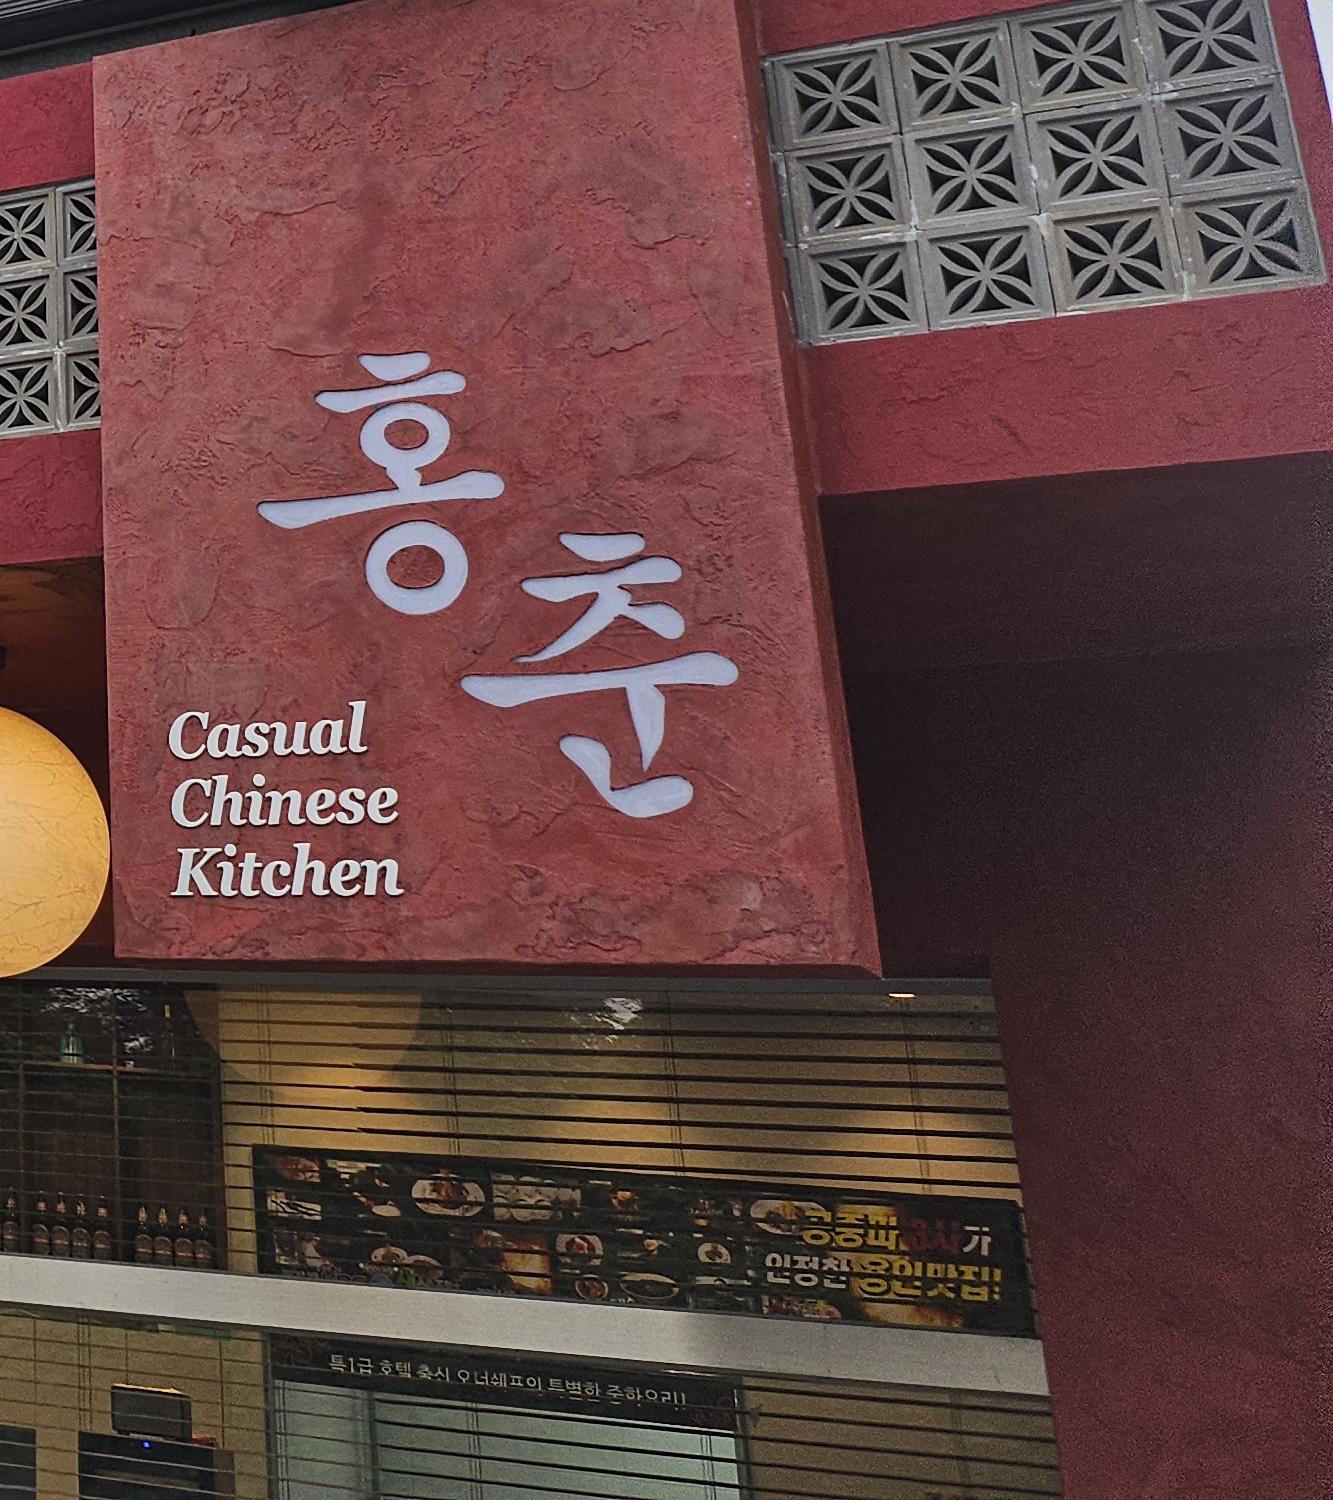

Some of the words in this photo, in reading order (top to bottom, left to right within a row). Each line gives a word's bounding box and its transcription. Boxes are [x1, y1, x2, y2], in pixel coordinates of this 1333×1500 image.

[256, 351, 739, 818] 홍춘
[167, 700, 368, 760] Casual
[169, 774, 399, 829] Chinese
[170, 842, 404, 899] Kitchen
[329, 1354, 374, 1375] 특1급
